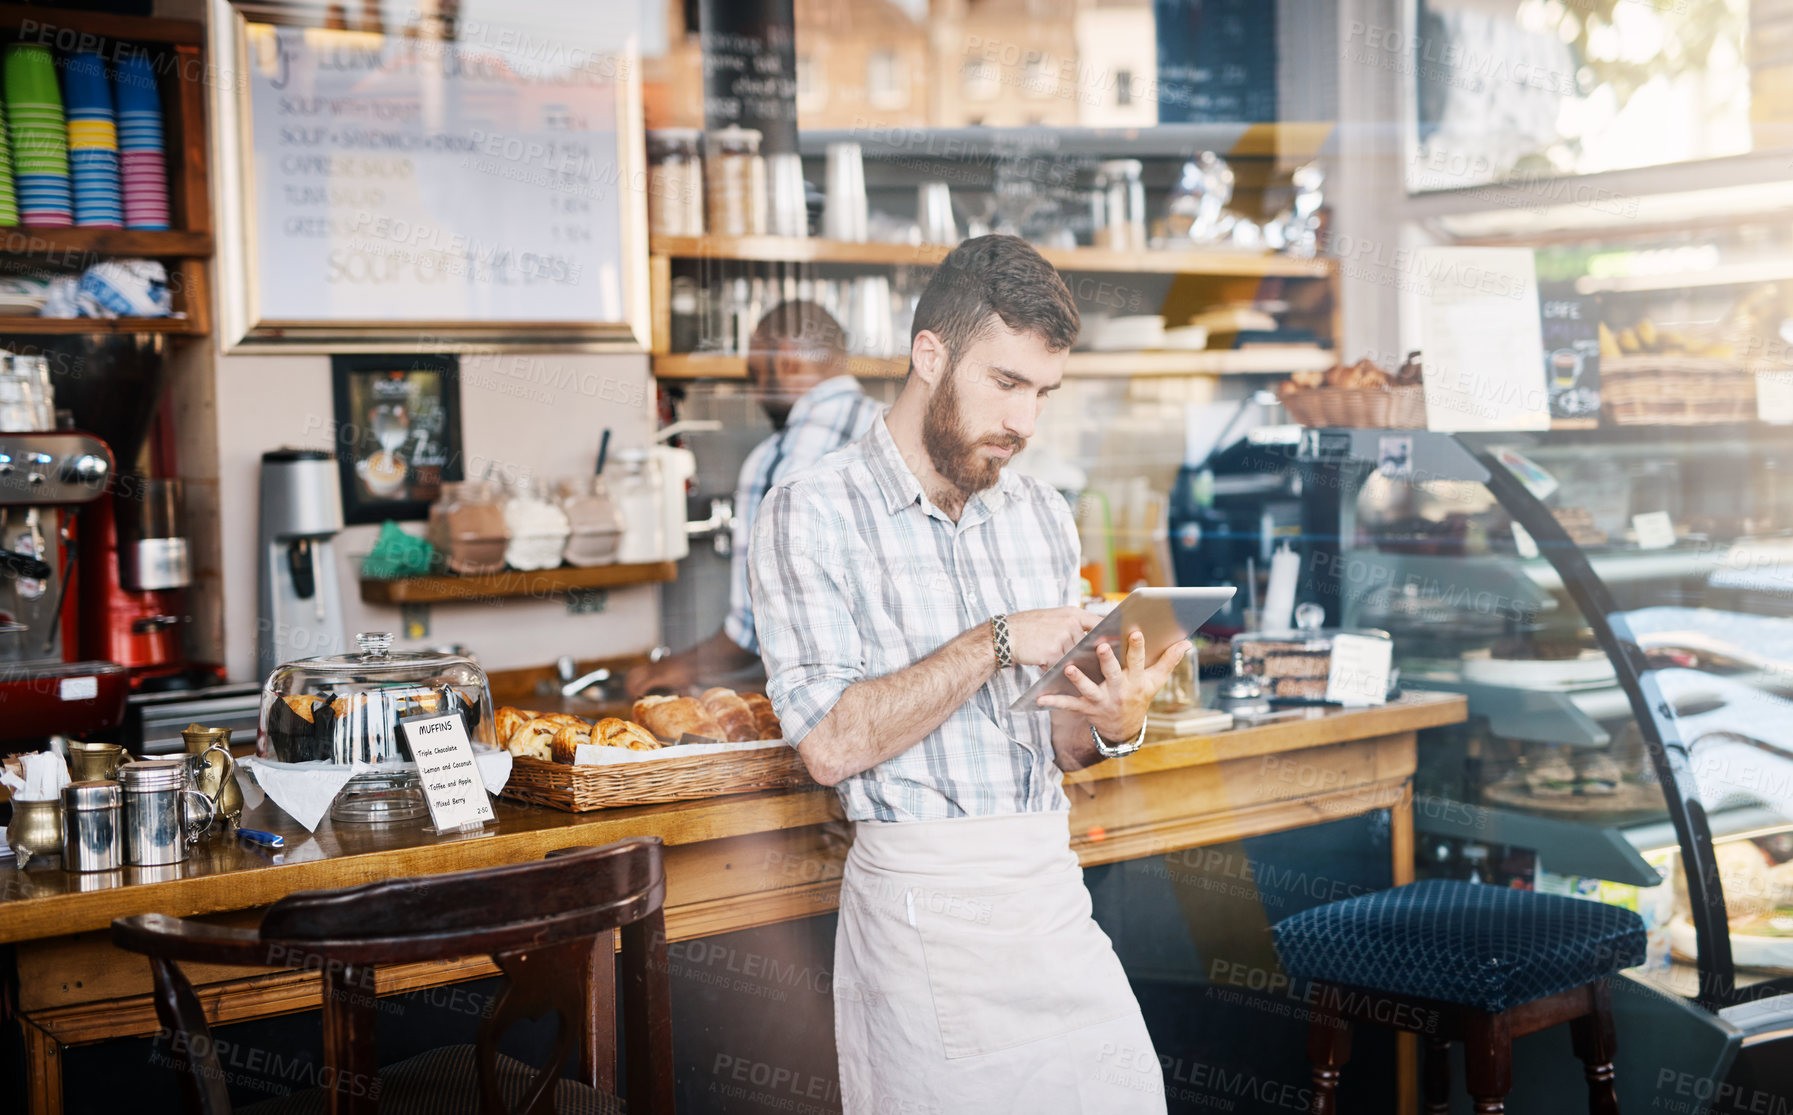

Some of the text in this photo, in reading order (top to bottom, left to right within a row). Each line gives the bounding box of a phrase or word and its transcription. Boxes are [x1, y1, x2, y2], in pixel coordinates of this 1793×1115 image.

[419, 720, 452, 735] MUFFINS
[434, 745, 458, 755] Chocolate
[442, 763, 451, 771] and
[452, 760, 472, 770] Coconut
[447, 779, 457, 788] and
[458, 777, 472, 787] Apple
[452, 796, 466, 806] Berry
